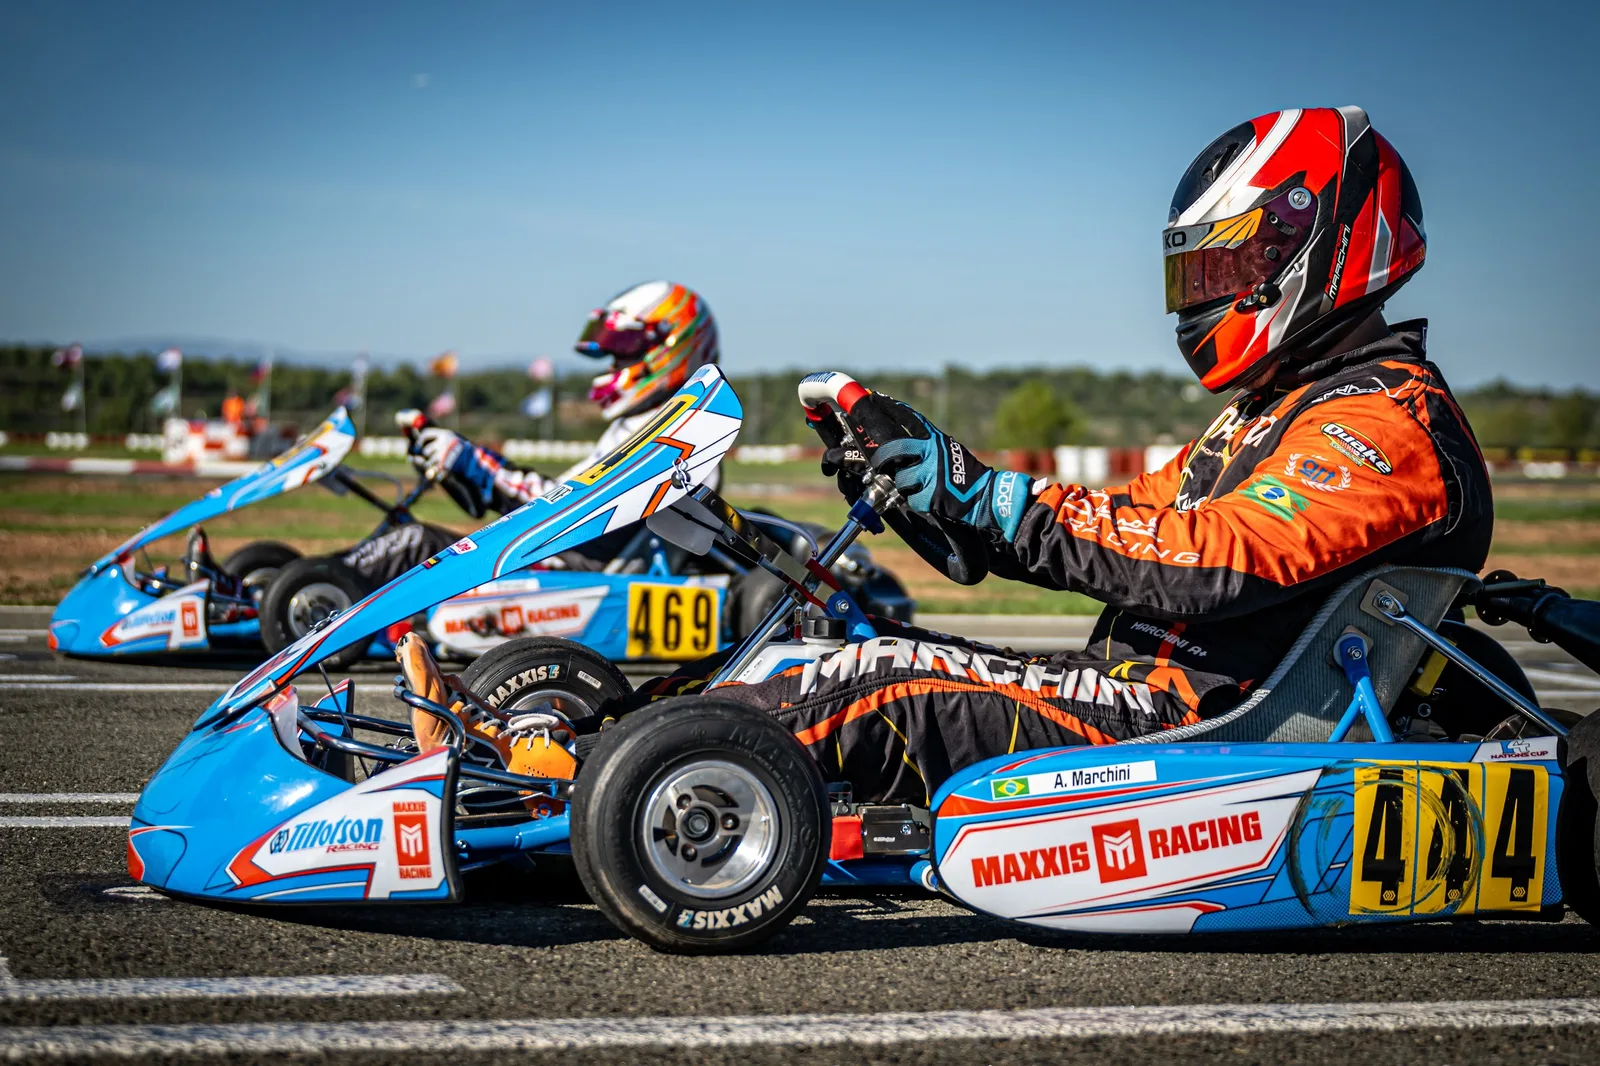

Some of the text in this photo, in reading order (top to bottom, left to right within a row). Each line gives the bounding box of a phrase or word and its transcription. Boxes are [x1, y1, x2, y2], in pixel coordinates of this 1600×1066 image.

[1328, 223, 1351, 300] MARCHINI
[1322, 422, 1392, 475] Quake
[633, 588, 712, 653] 469
[1130, 621, 1190, 649] MARCHINI
[1490, 751, 1529, 759] NATIONS
[1054, 764, 1130, 789] A. Marchini
[392, 801, 427, 813] MAXXIS
[285, 815, 384, 853] Tillotson
[326, 843, 380, 854] RACING
[971, 811, 1262, 888] MAXXIS RACING
[1360, 768, 1538, 906] 444
[399, 866, 433, 880] RACING
[693, 884, 784, 930] MAXXIS
